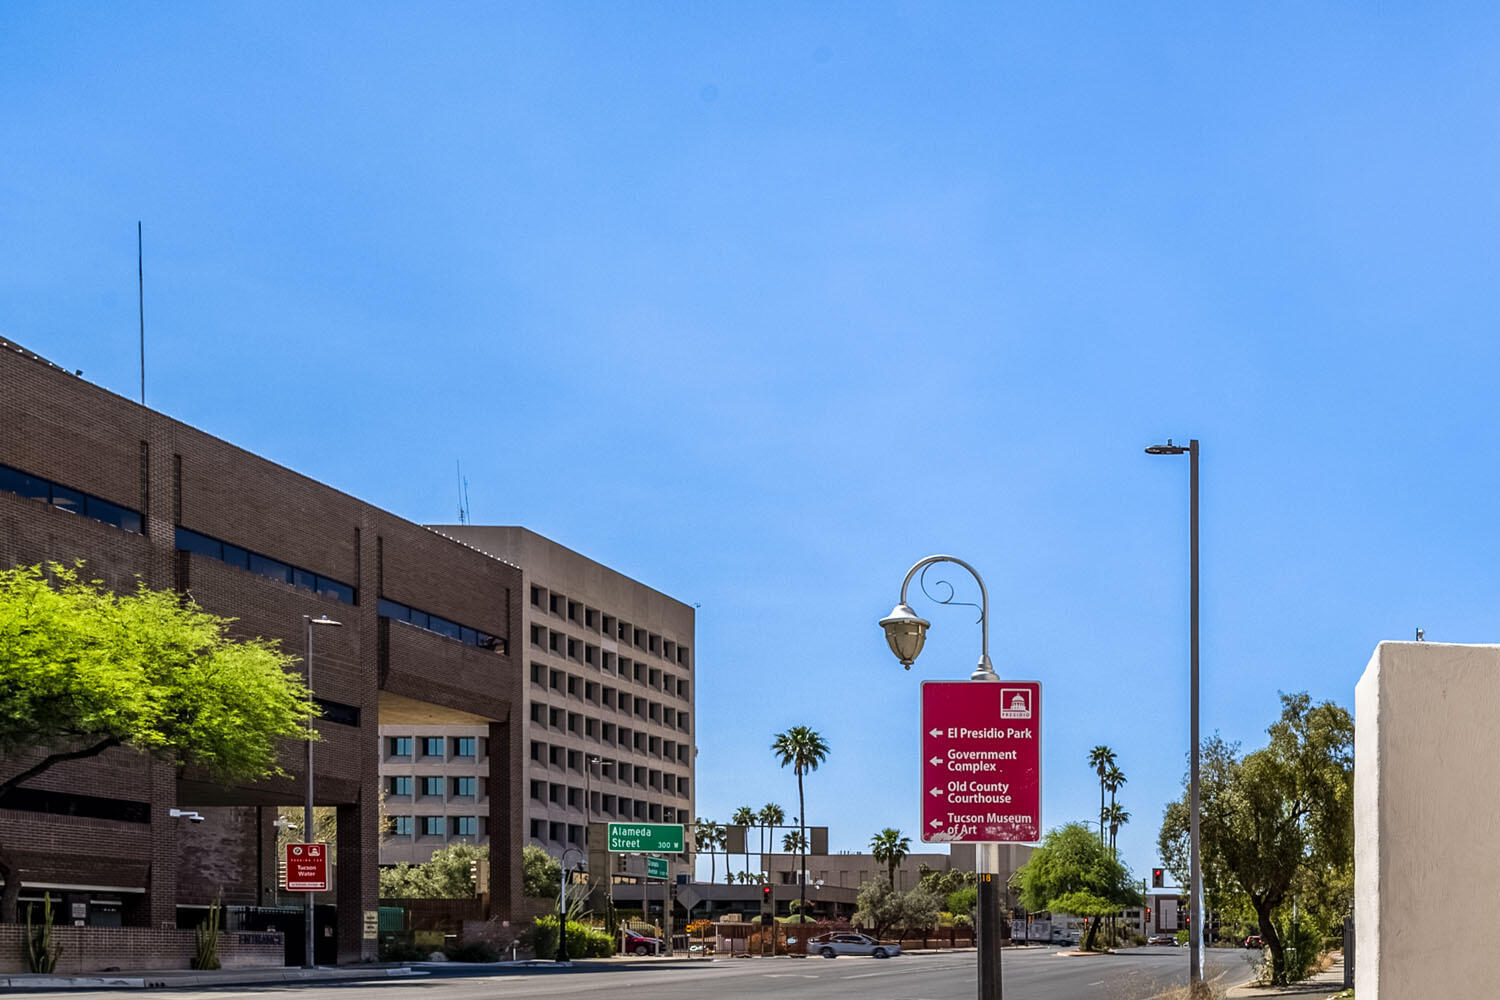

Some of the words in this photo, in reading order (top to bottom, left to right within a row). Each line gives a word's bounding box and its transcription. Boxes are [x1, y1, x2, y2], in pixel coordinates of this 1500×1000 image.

[947, 728, 957, 738] El
[960, 728, 1004, 739] Presidio
[1007, 728, 1032, 739] Park
[947, 749, 1017, 760] Government
[947, 760, 996, 773] Complex
[947, 781, 967, 792] Old
[969, 781, 1009, 795] County
[947, 792, 1012, 804] Courthouse
[947, 813, 984, 823] Tucson
[986, 813, 1032, 823] Museum
[612, 826, 652, 837] Alameda
[947, 824, 960, 835] of
[961, 824, 977, 835] Art
[612, 838, 640, 848] Street
